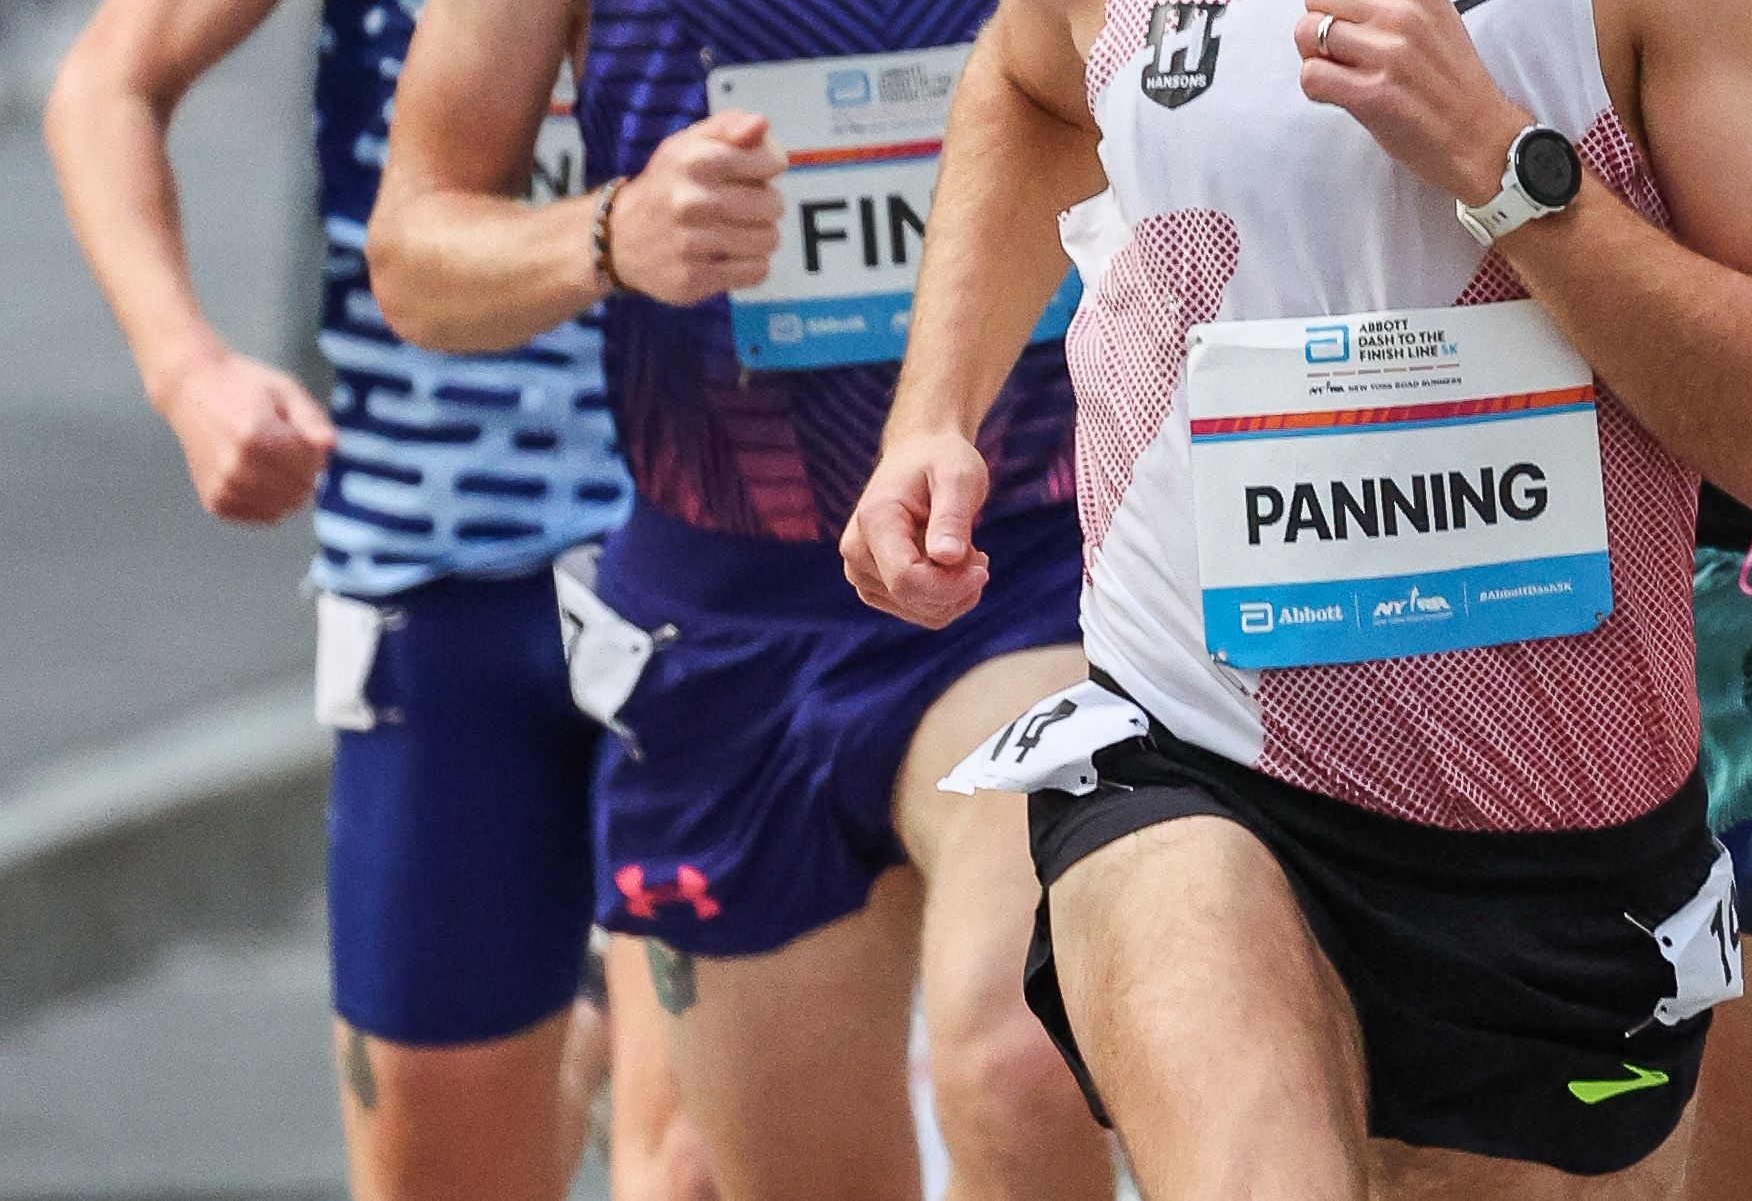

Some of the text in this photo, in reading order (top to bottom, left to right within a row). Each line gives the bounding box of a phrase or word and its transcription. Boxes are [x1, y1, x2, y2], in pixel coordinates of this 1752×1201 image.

[1146, 72, 1208, 91] HANSONS
[1359, 318, 1409, 334] ABBOTT
[1358, 330, 1446, 348] DASH TO THE
[1359, 346, 1404, 362] FINISH
[1407, 345, 1438, 359] LINE
[1244, 462, 1549, 546] PANNING
[1279, 603, 1344, 625] Abbott
